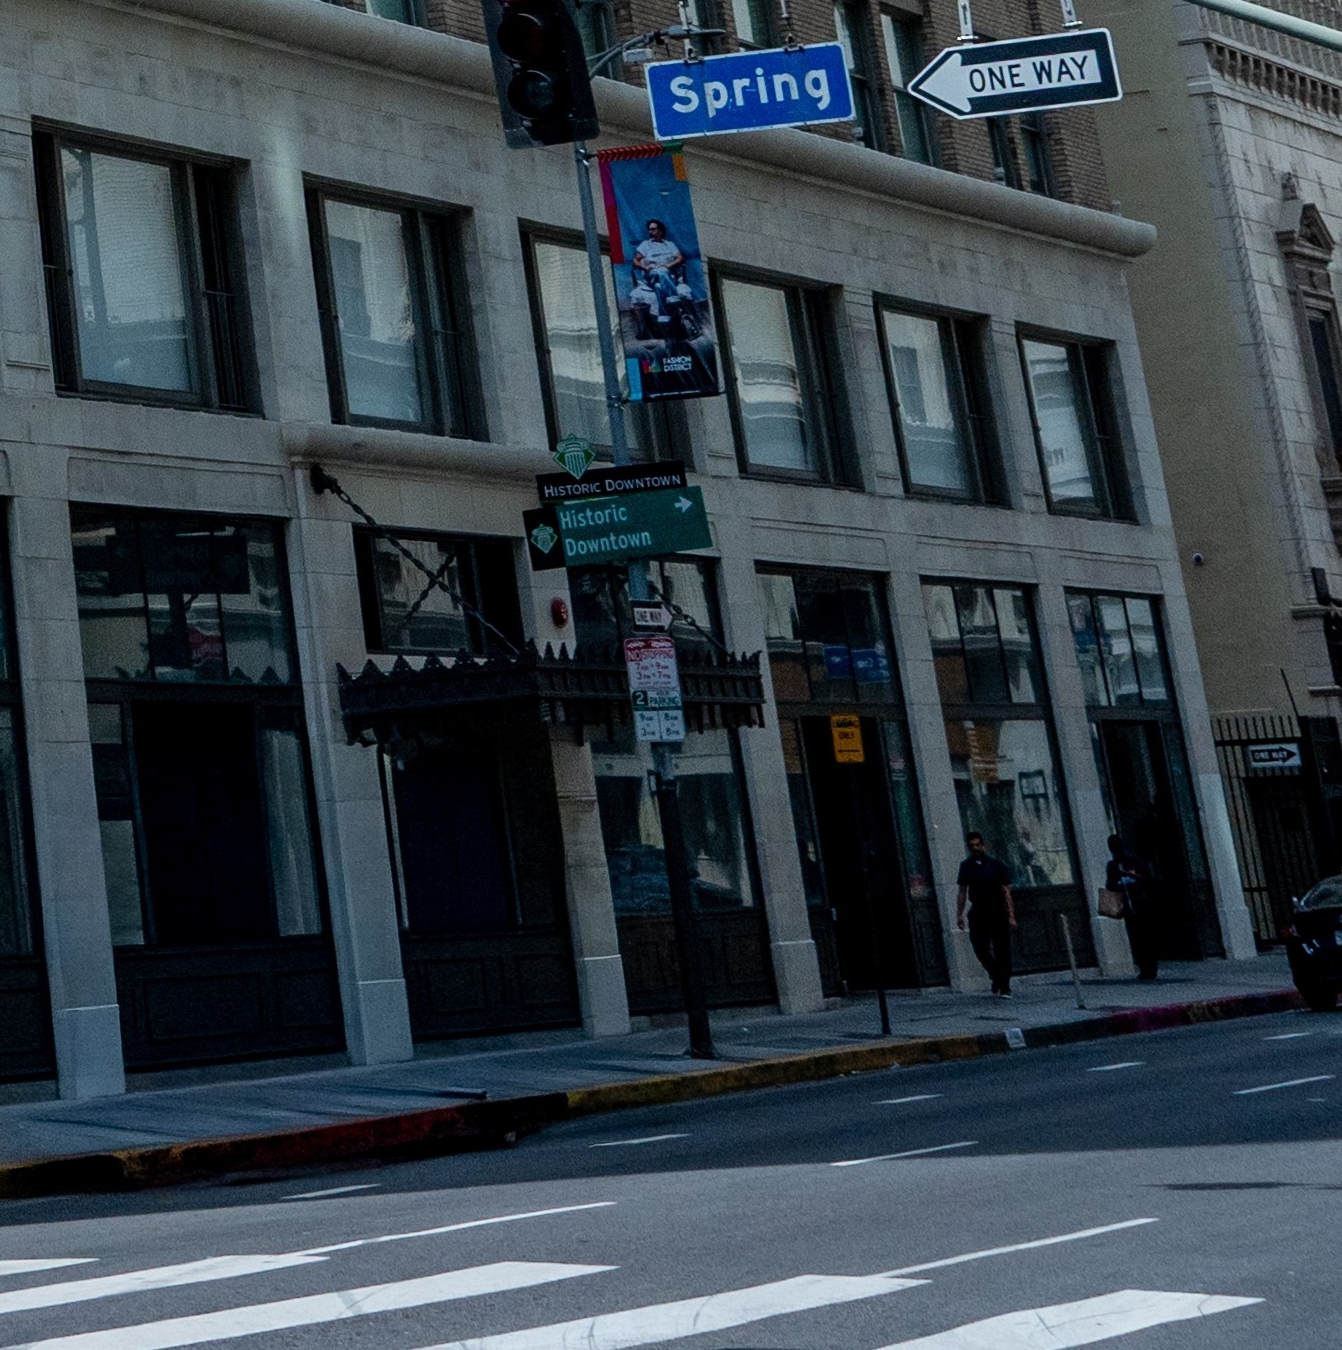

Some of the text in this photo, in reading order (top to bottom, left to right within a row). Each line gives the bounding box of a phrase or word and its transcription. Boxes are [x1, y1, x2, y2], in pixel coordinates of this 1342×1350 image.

[969, 55, 1090, 93] ONE WAY
[670, 67, 830, 118] Spring
[543, 473, 682, 498] HISTORIC DOWNTOWN
[559, 504, 629, 530] Historic
[565, 528, 653, 557] Downtown
[636, 692, 645, 704] 2
